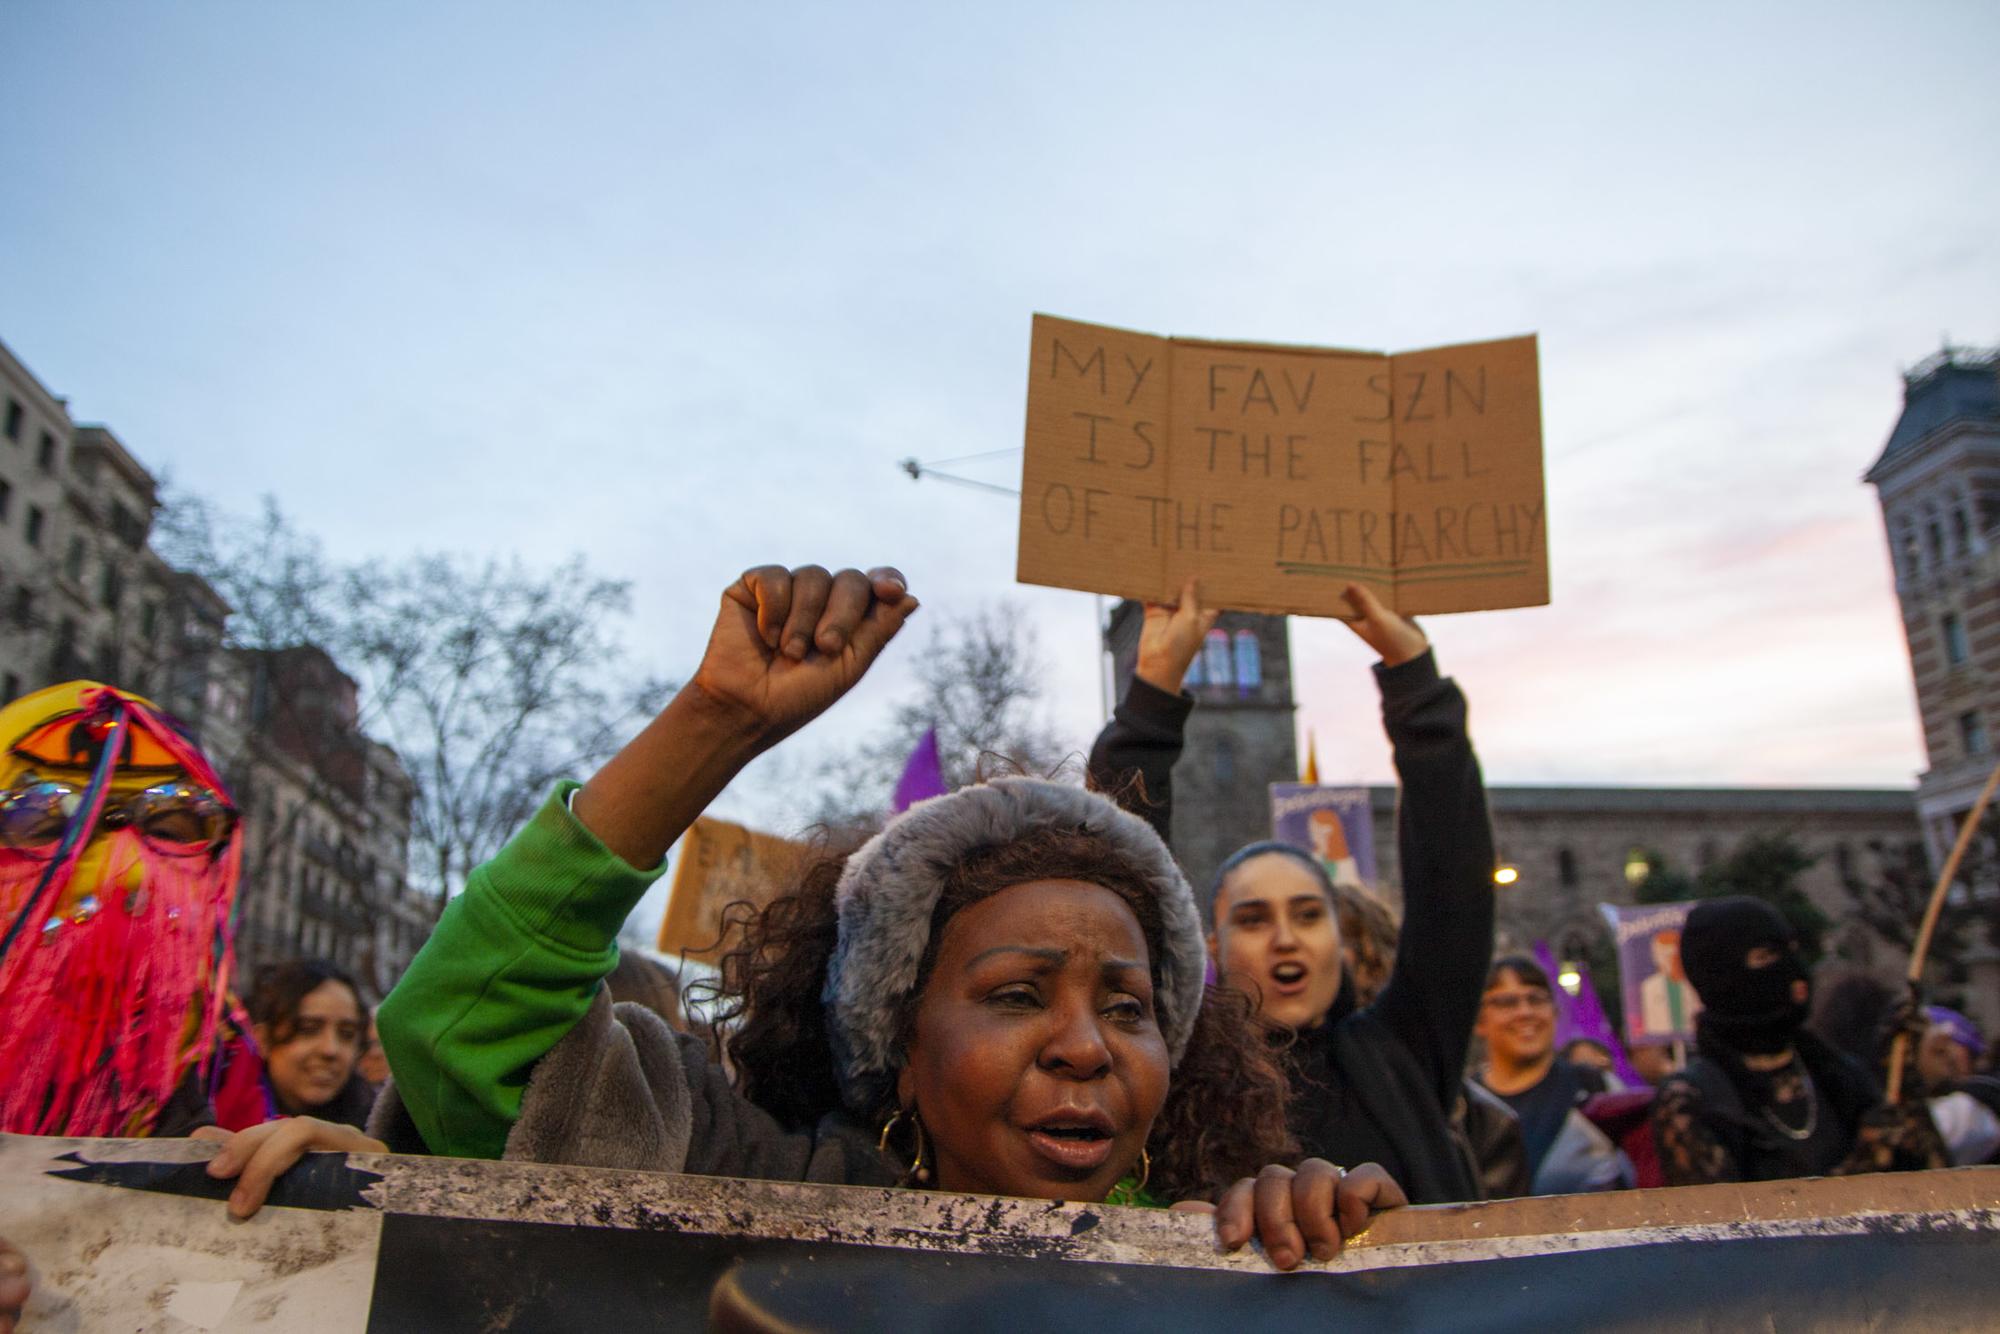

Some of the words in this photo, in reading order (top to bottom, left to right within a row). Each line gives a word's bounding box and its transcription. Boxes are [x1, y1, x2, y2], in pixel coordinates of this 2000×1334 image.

[1050, 337, 1153, 406] MY
[1208, 364, 1317, 415] FAV
[1352, 364, 1487, 423] SZN
[1073, 411, 1156, 471] IS
[1195, 427, 1308, 481] THE
[1358, 440, 1492, 484] FALL
[1041, 482, 1112, 541] OF
[1134, 494, 1234, 553] THE
[1276, 500, 1544, 566] PATRIARCHY
